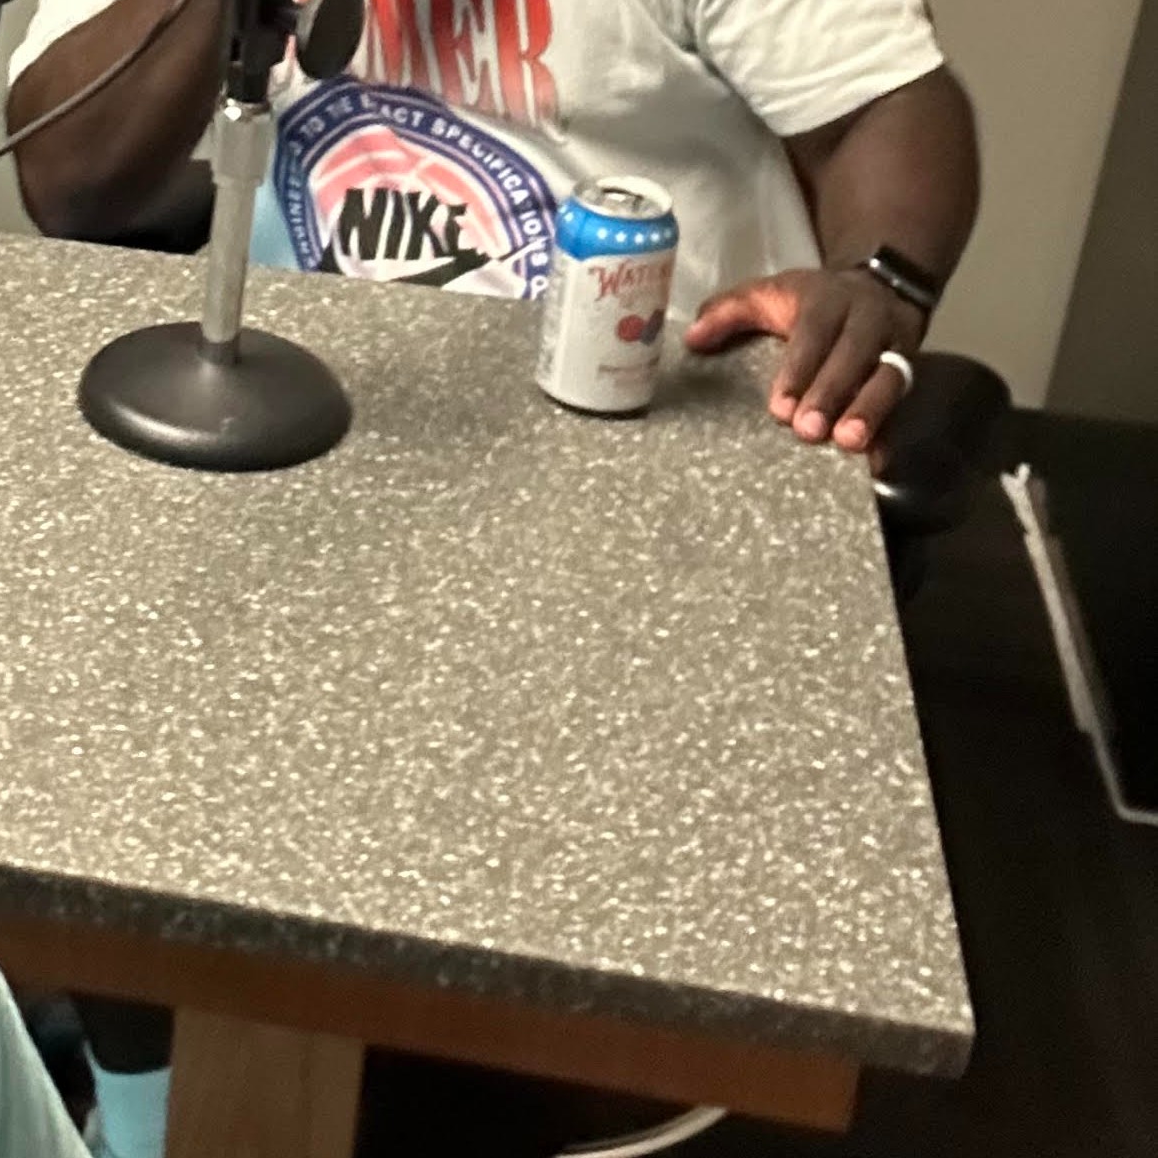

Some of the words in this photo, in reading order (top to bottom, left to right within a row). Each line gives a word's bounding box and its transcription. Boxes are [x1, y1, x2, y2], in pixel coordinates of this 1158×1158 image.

[338, 187, 468, 260] NIKE
[359, 93, 425, 127] EACT
[430, 117, 549, 267] SPECIFICAIONS
